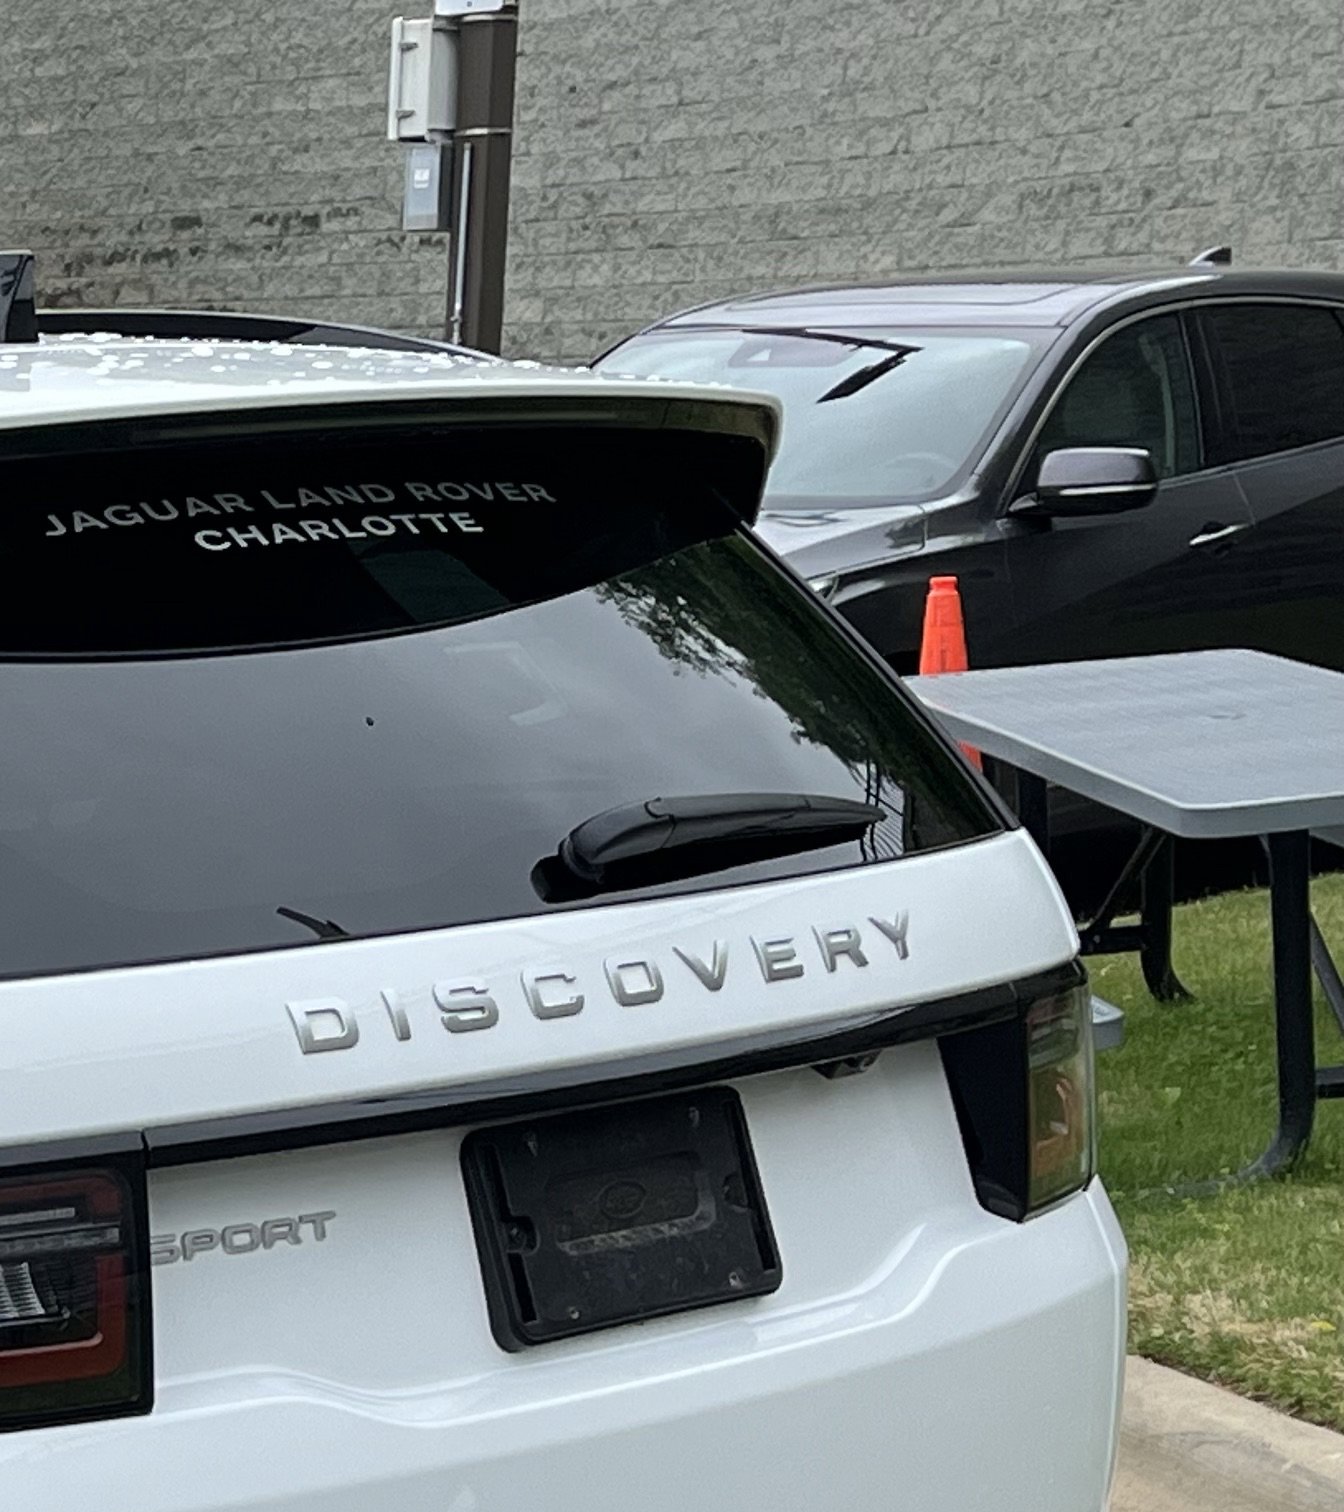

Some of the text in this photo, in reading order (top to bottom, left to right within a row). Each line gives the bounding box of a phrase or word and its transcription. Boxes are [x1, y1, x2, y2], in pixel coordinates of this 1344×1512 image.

[45, 480, 557, 537] JAGUAR LAND ROVER
[194, 511, 484, 551] CHARLOTTE
[284, 909, 911, 1055] DISCOVERY
[151, 1210, 337, 1266] SPORT
